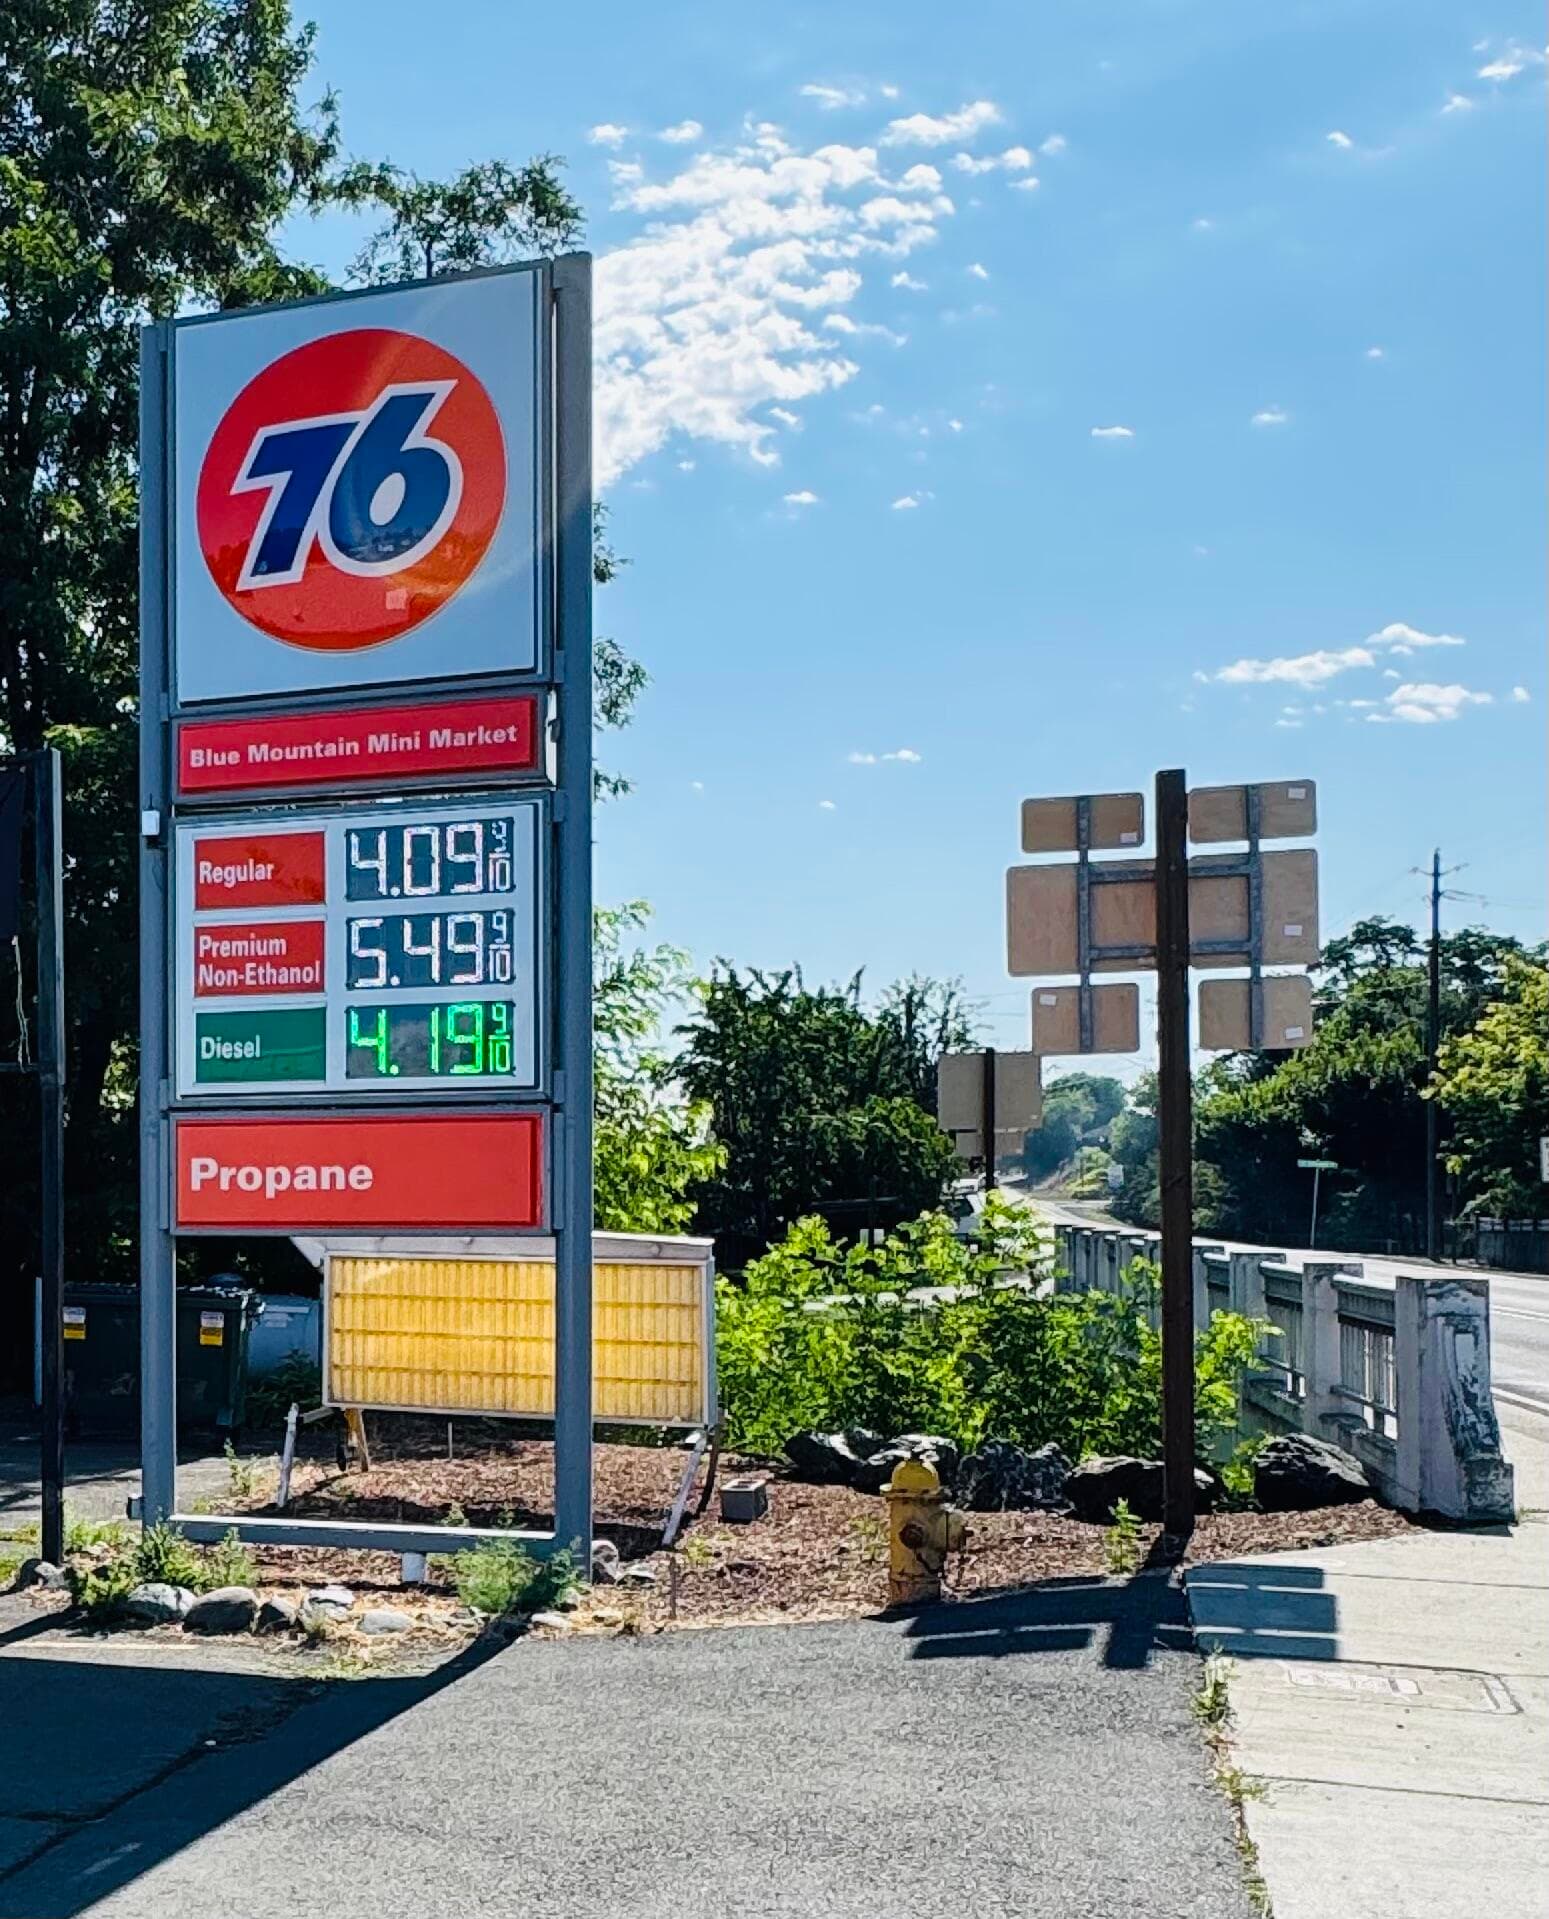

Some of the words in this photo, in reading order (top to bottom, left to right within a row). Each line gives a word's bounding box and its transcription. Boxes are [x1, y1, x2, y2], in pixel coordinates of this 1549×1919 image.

[230, 379, 464, 592] 76
[189, 748, 241, 768] Blue
[247, 738, 360, 764] Mountain
[367, 730, 421, 754] Mini
[428, 723, 518, 749] Market
[199, 858, 275, 888] Regular
[351, 822, 483, 897] 4.09
[199, 932, 287, 958] Premium
[351, 912, 483, 988] 5.49
[199, 960, 321, 987] Non-Ethanol
[200, 1034, 261, 1060] Diesel
[350, 1003, 483, 1075] 4.19
[190, 1157, 374, 1200] Propane
